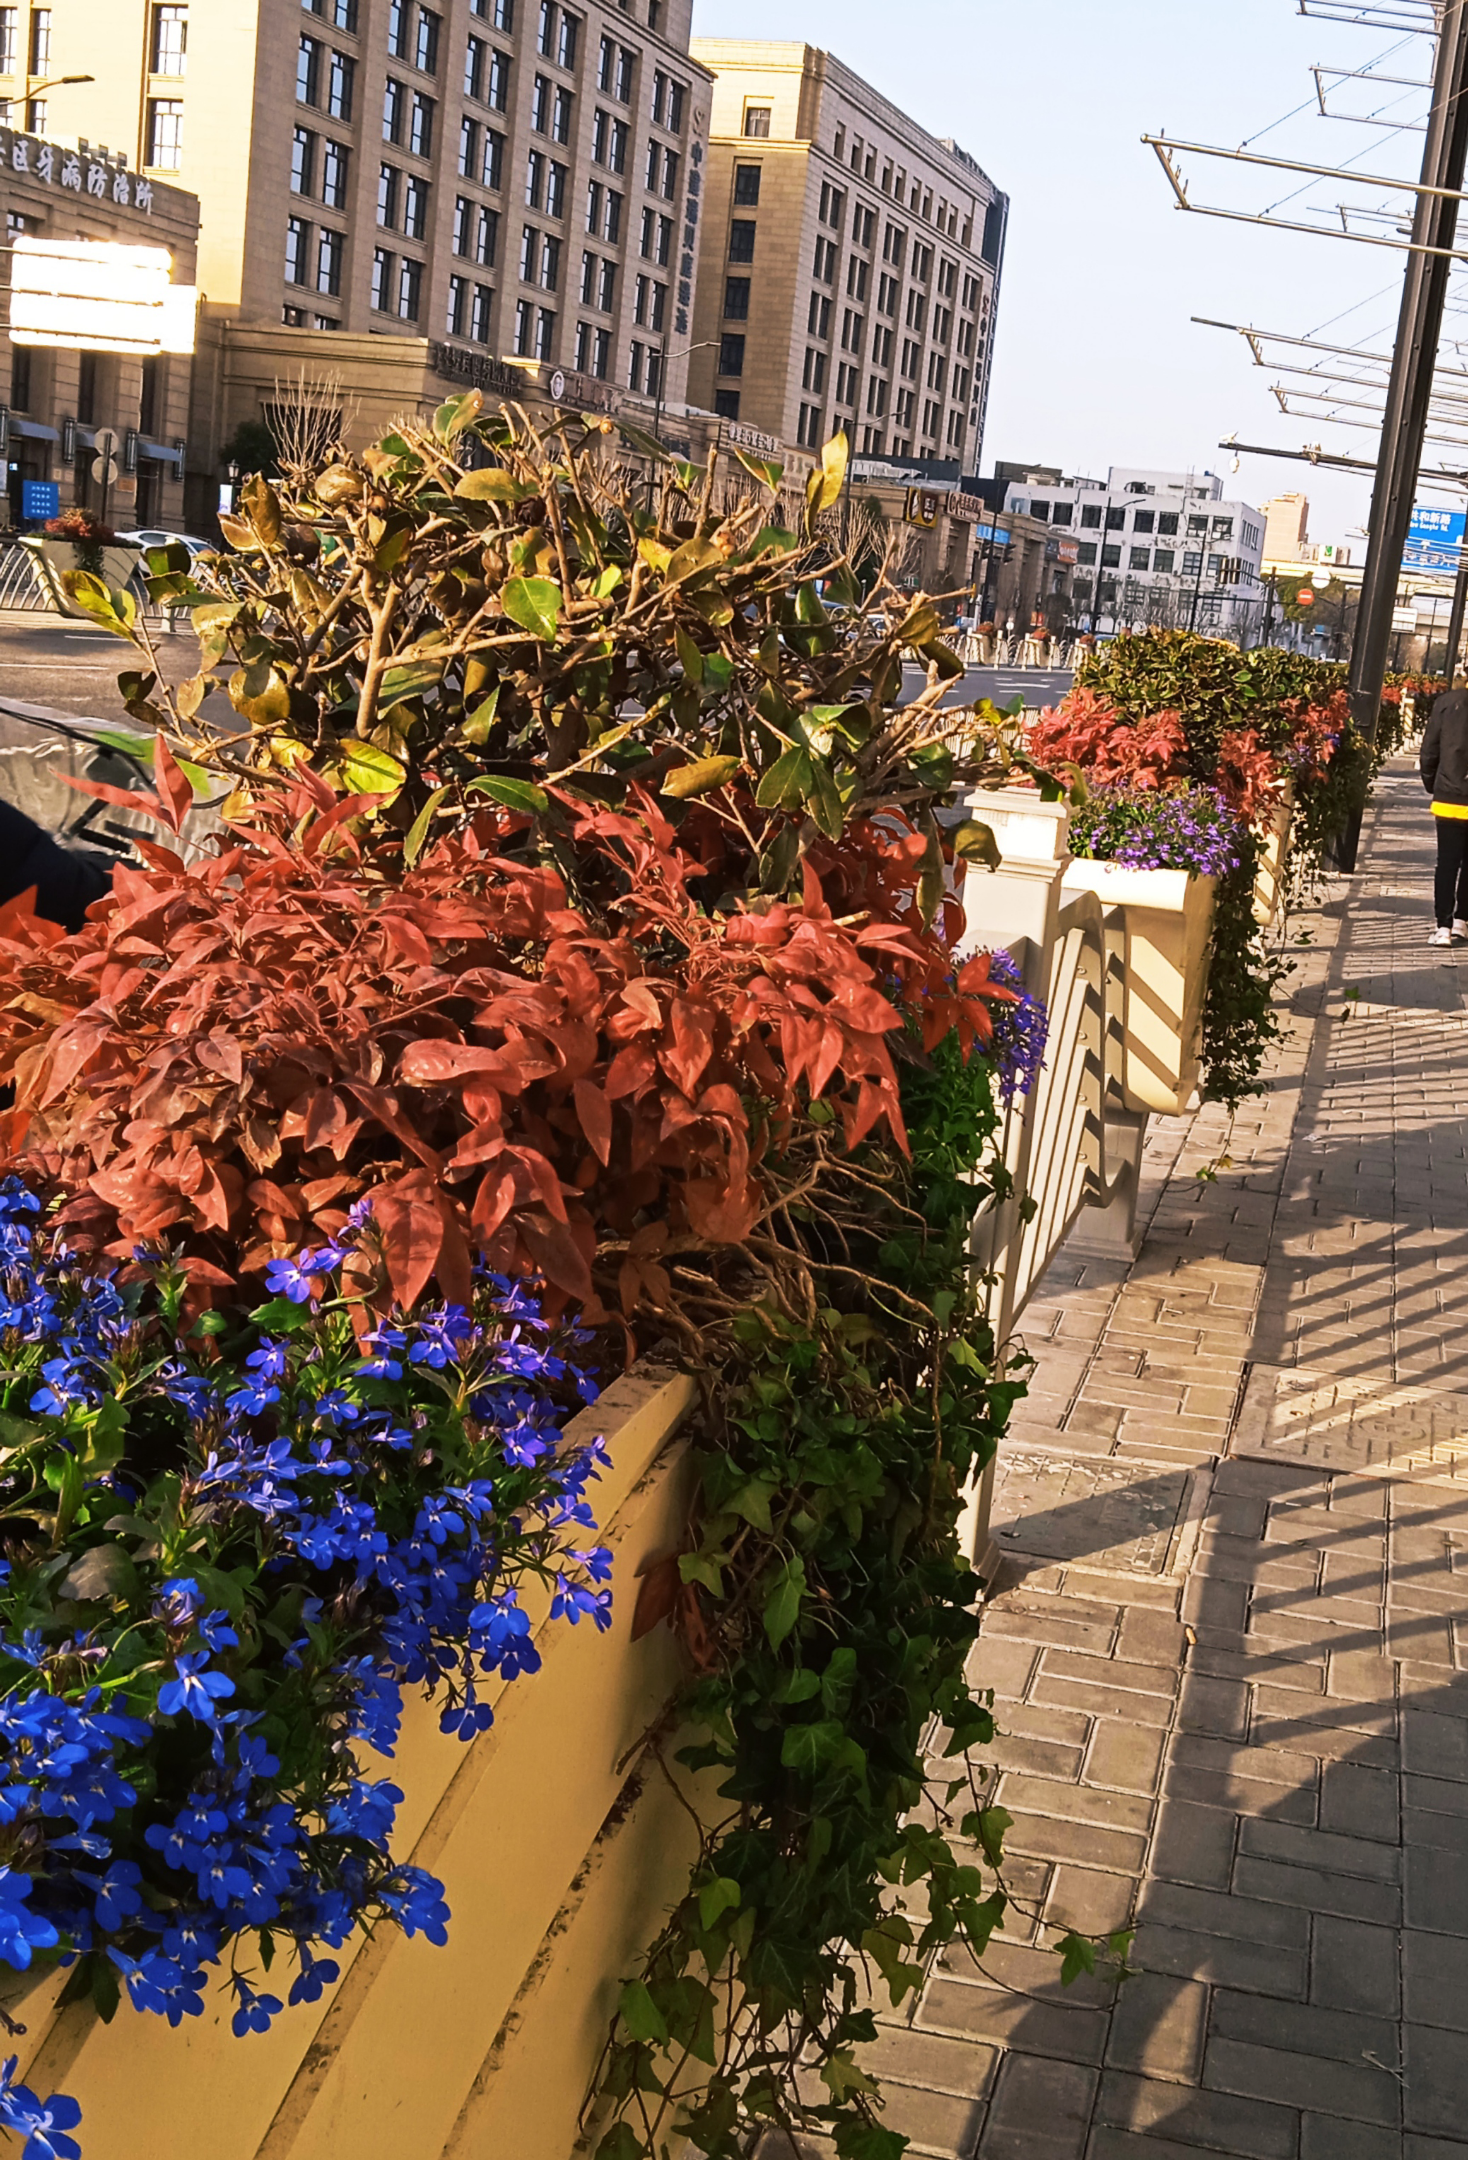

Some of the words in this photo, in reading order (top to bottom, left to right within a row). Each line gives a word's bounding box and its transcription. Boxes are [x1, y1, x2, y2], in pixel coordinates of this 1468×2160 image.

[0, 133, 154, 216] 区牙病防治所
[1411, 510, 1451, 525] 共和新路
